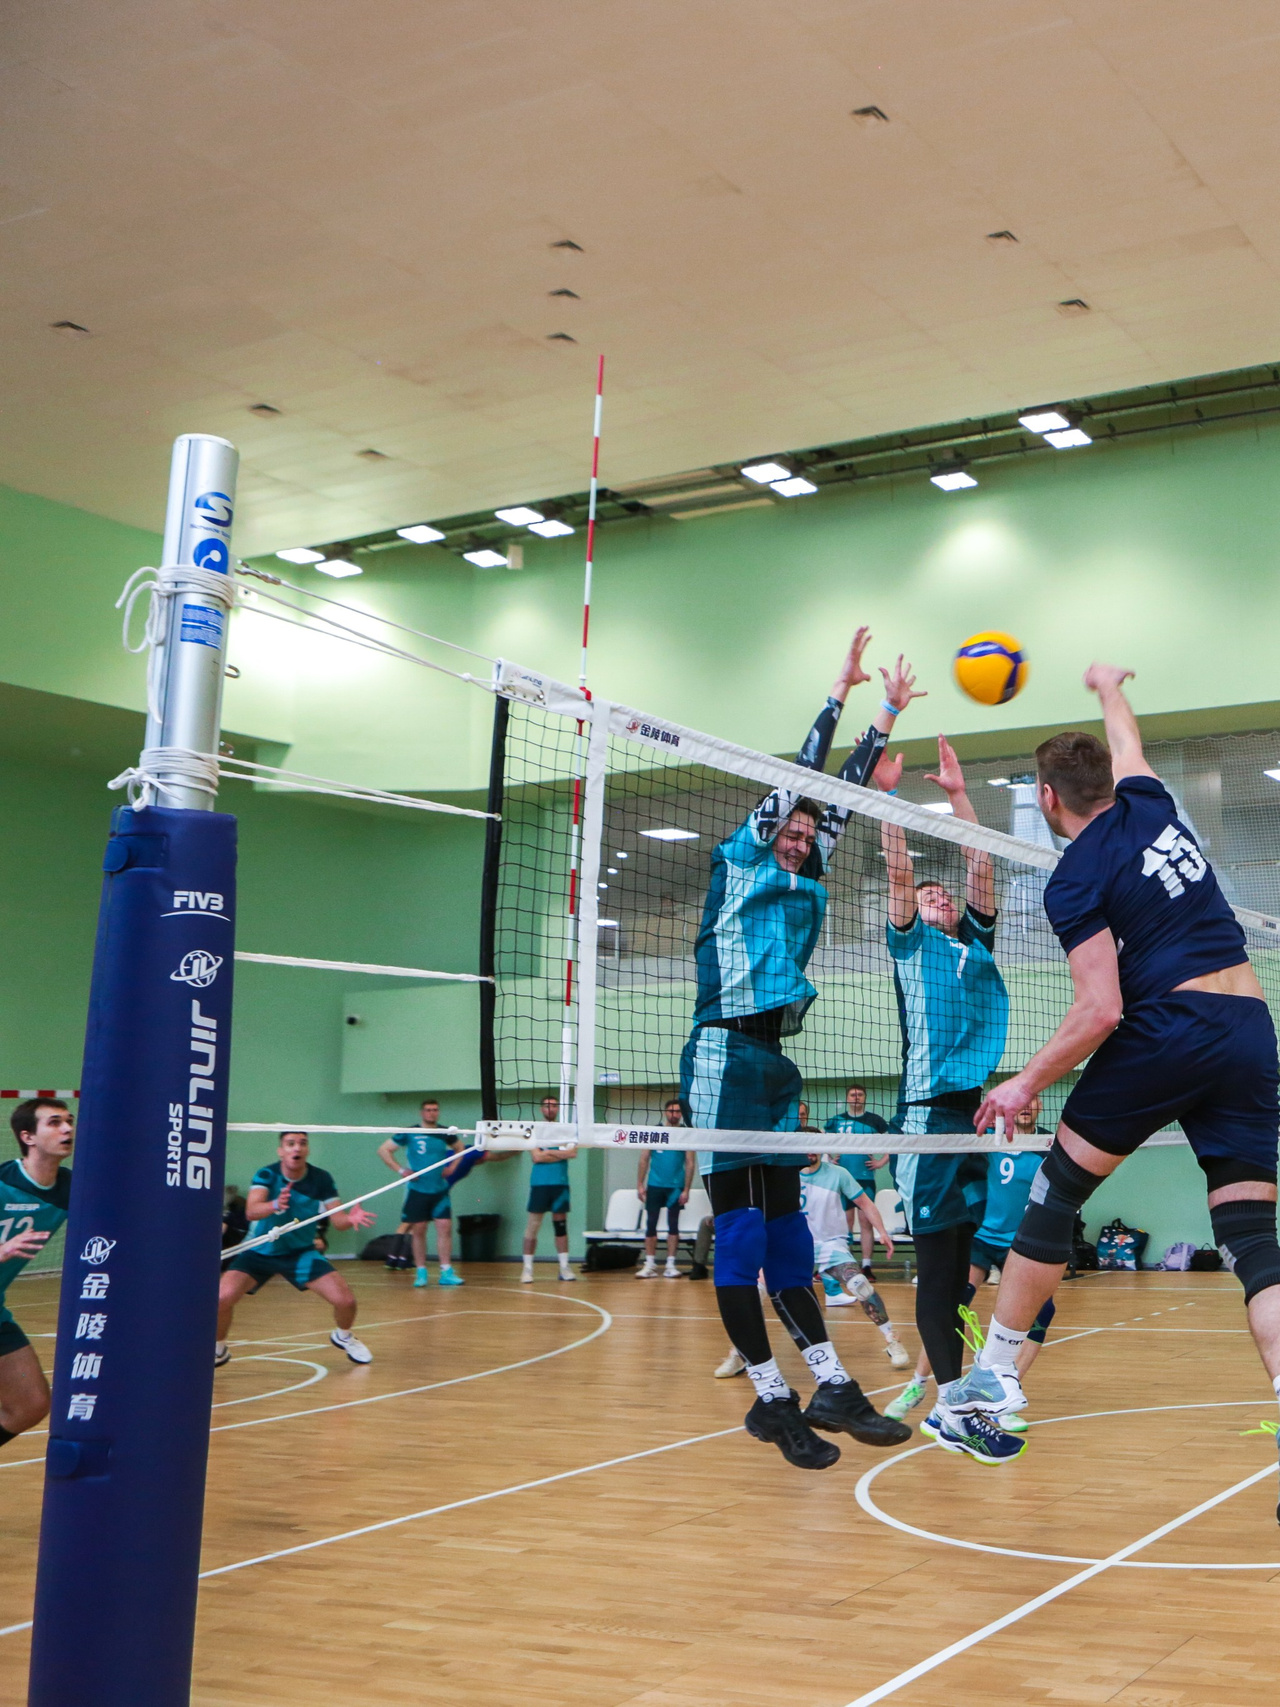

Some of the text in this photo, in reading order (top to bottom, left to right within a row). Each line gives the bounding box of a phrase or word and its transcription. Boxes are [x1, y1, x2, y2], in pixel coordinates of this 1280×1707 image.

[640, 723, 680, 747] 金陵体育
[1141, 823, 1207, 899] 15
[173, 890, 224, 911] FIVB
[949, 940, 969, 979] 7
[185, 999, 218, 1190] JINLING
[167, 1103, 183, 1187] SPORTS
[416, 1140, 427, 1155] 3
[629, 1130, 670, 1144] 金陵体育
[999, 1157, 1015, 1185] 9
[67, 1272, 111, 1421] 金陵体育
